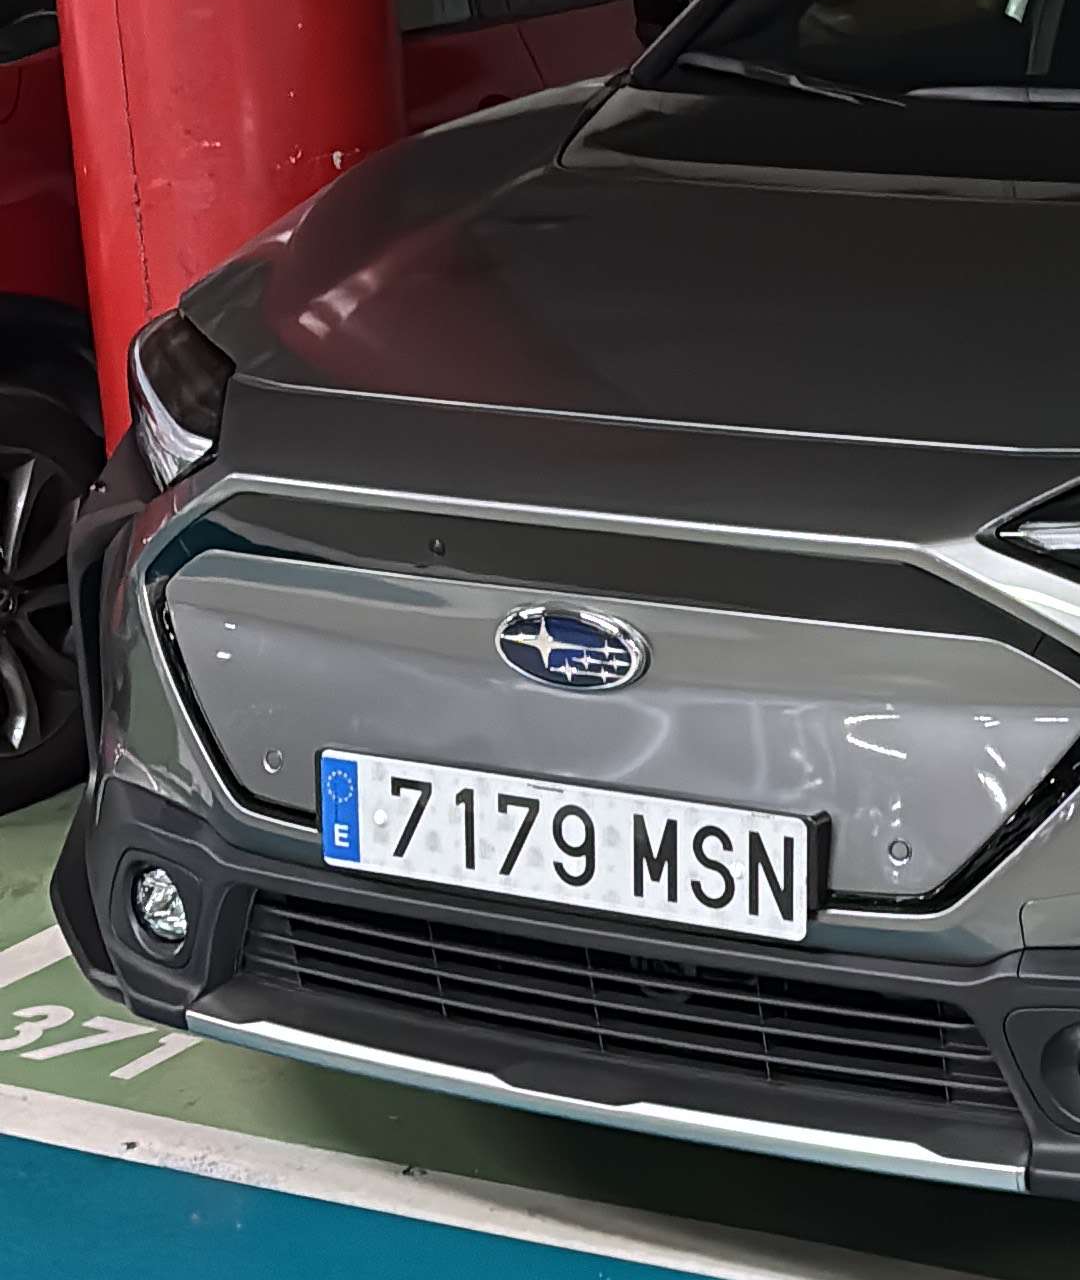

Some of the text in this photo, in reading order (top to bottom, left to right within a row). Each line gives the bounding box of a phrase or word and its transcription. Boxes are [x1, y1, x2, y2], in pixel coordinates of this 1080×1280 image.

[333, 823, 349, 848] E
[390, 776, 795, 922] 7179 MSN
[0, 1004, 205, 1080] 371
